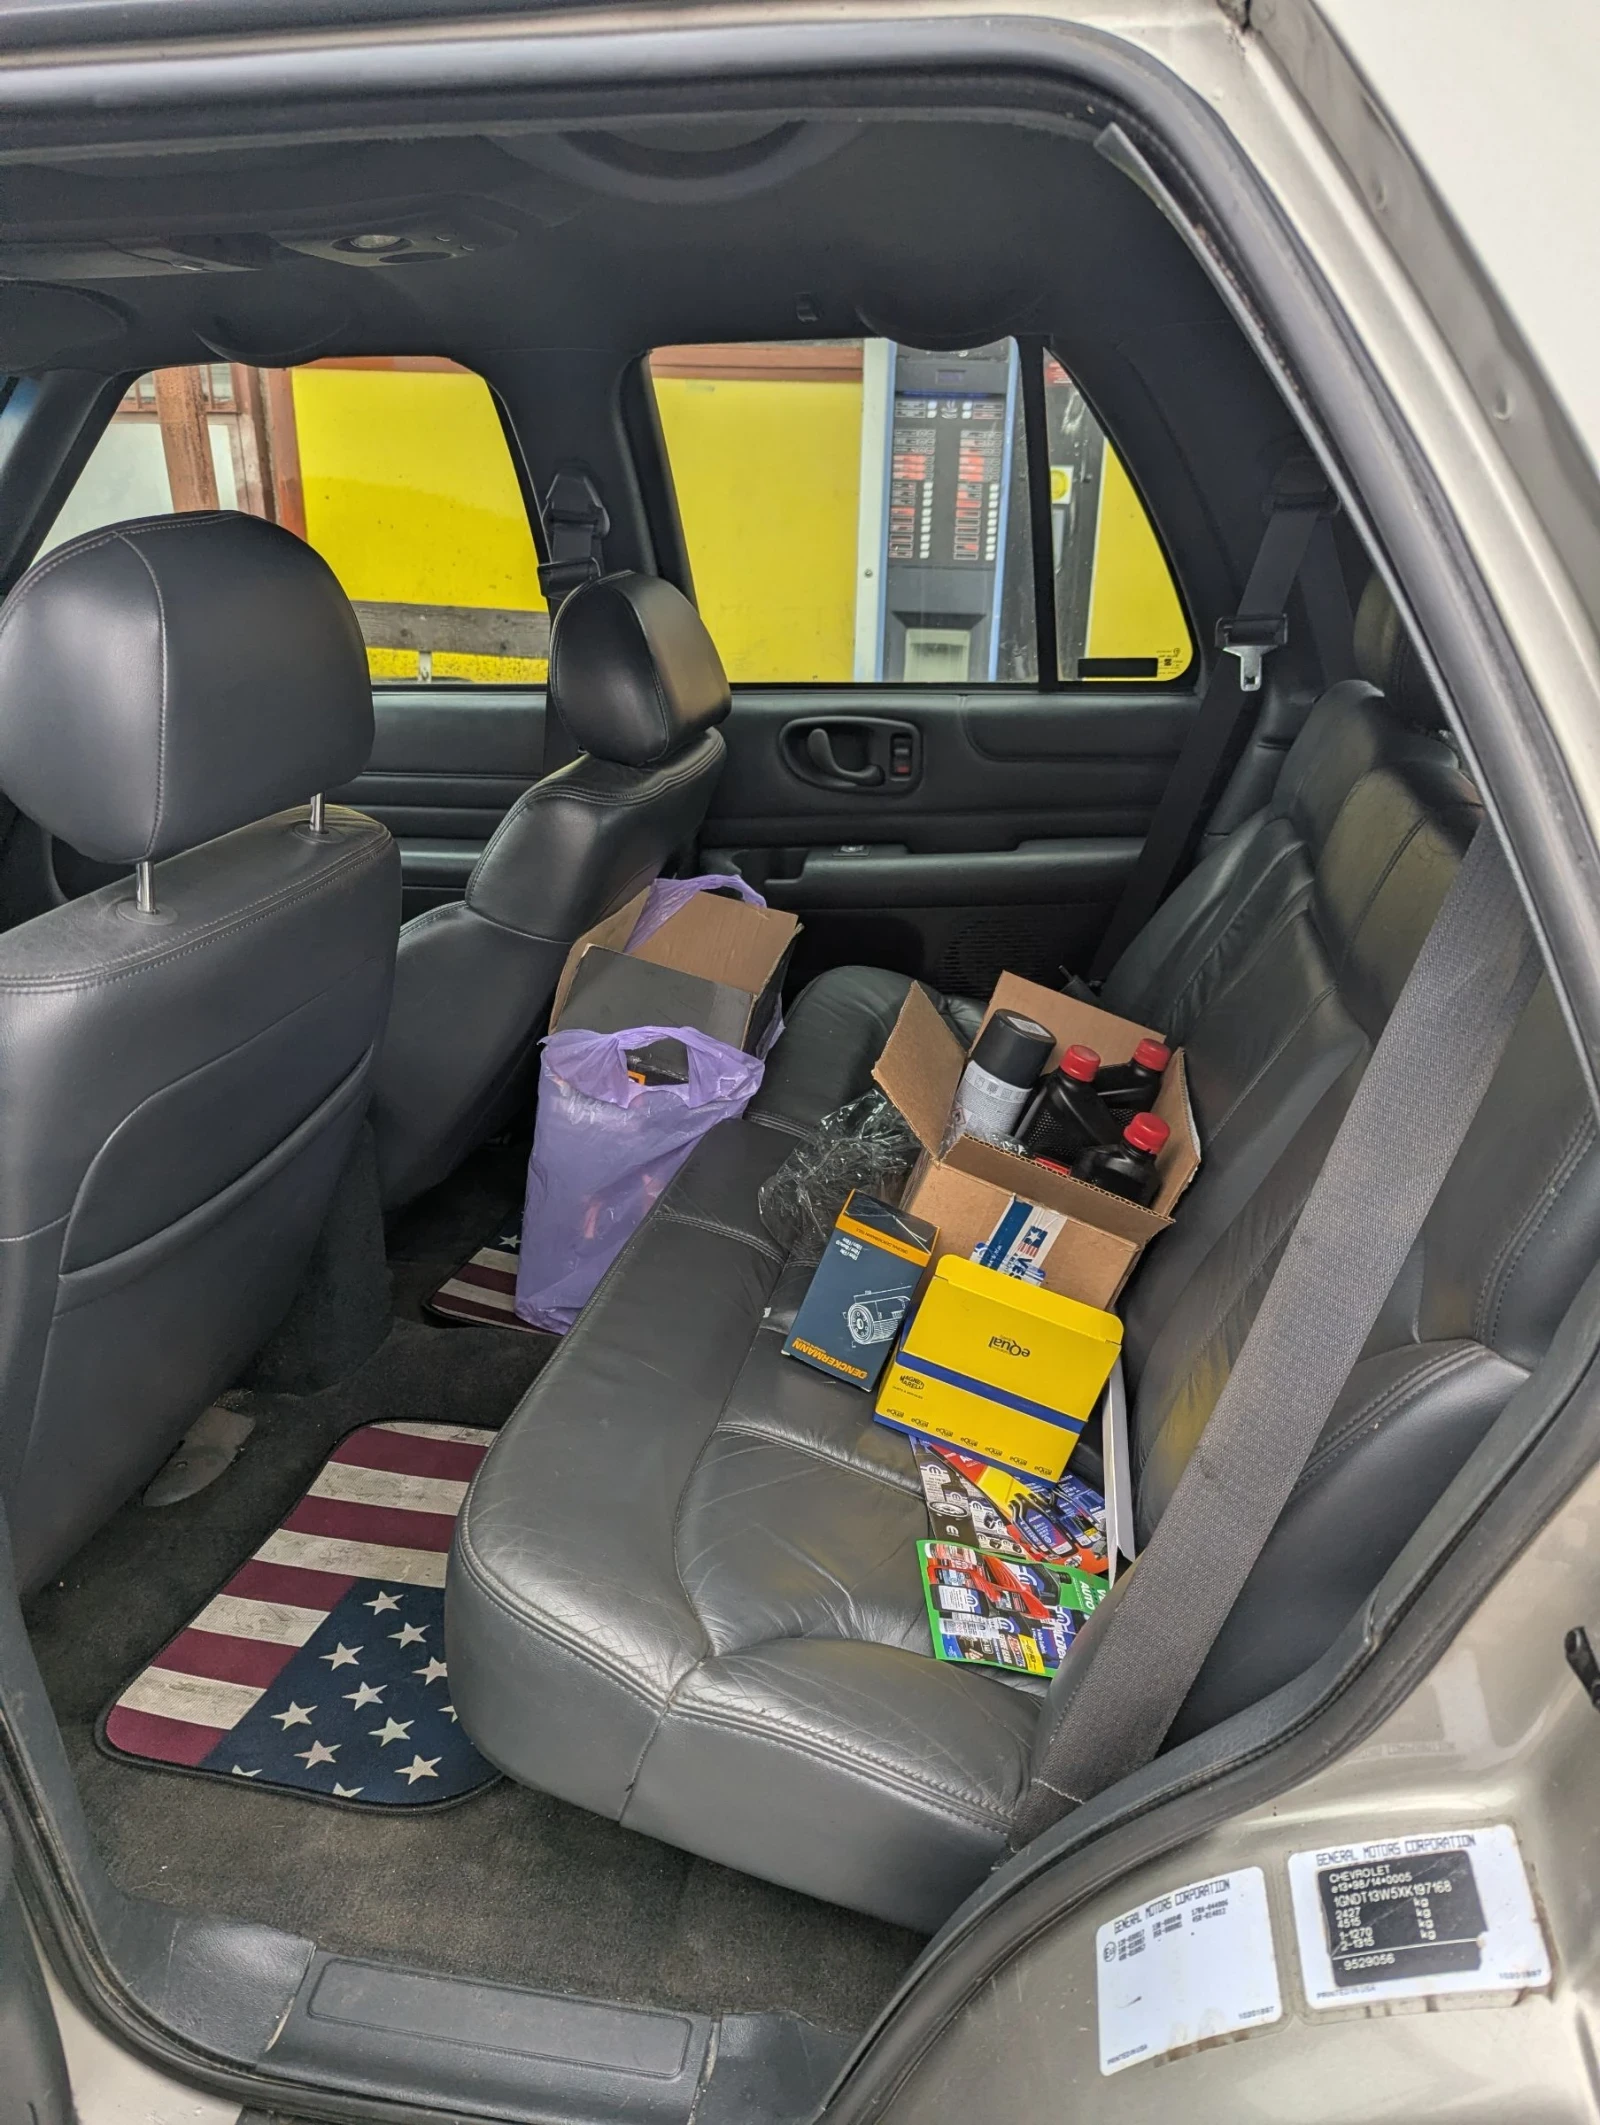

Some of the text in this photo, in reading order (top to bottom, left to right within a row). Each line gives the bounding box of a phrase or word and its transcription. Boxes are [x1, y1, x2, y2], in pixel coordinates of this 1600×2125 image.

[988, 1336, 1030, 1357] eQual
[791, 1338, 868, 1379] DENCKERMANN
[1079, 1580, 1095, 1610] AUTO
[1316, 1835, 1476, 1866] GENERAL MOTORS CORPORATION
[1329, 1865, 1391, 1883] CHEVROLET
[1333, 1880, 1452, 1908] 1GNDT13W5XK197168
[1114, 1912, 1142, 1934] GENERAL
[1145, 1897, 1173, 1918] MOTORS
[1175, 1879, 1231, 1905] CORPORATION
[1335, 1898, 1429, 1920] 2427 kg
[1337, 1908, 1431, 1928] 4515 kg
[1339, 1919, 1434, 1940] 1-1270 kg
[1340, 1930, 1436, 1951] 2-1315 kg
[1343, 1953, 1395, 1970] 9529056
